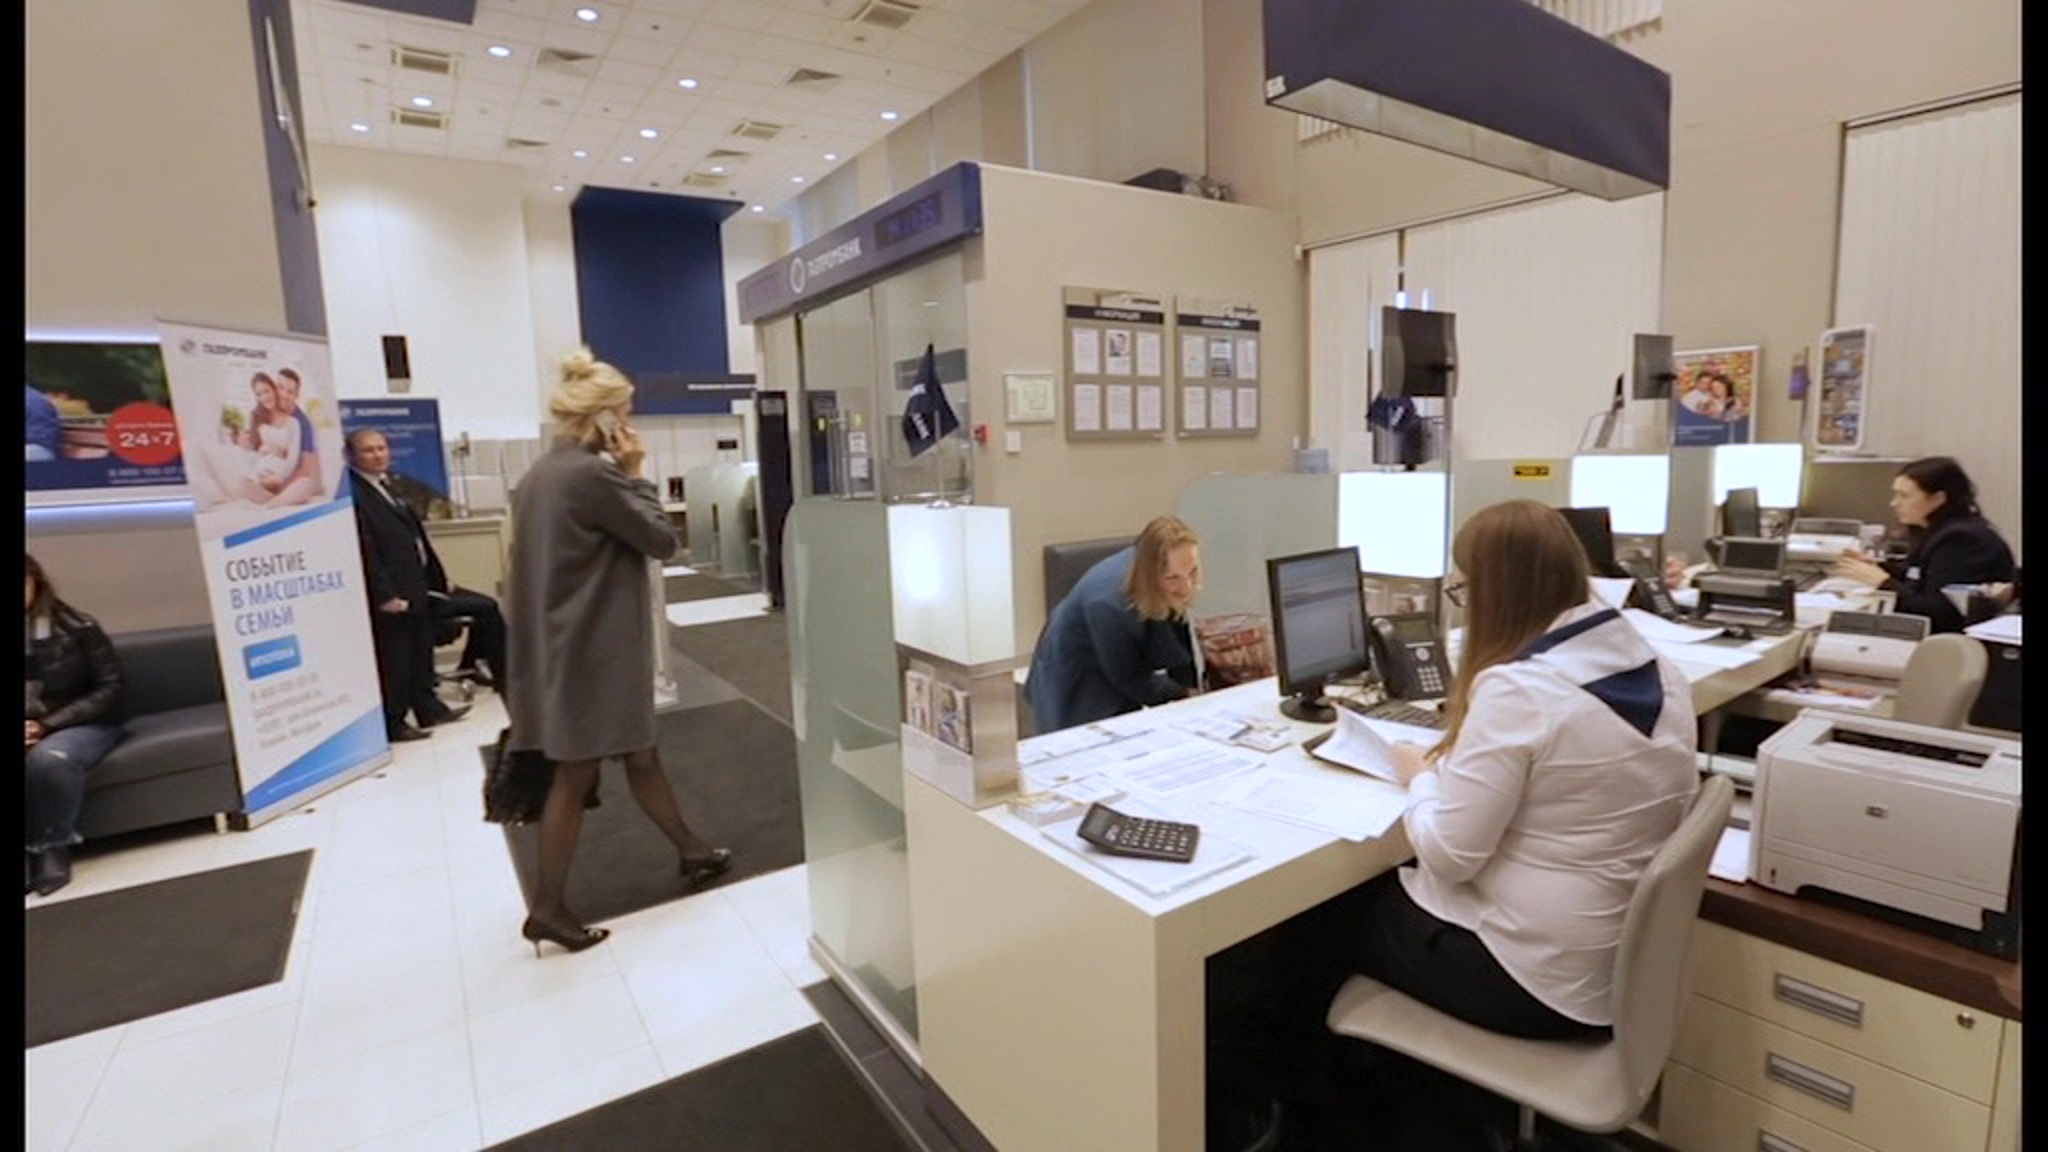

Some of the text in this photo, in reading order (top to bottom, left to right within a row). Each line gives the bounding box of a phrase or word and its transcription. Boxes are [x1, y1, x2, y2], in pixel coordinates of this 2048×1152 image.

[225, 551, 306, 582] СОБЫТИЕ
[230, 570, 345, 610] В МАСШТАБАХ
[235, 605, 295, 636] СЕМЬИ
